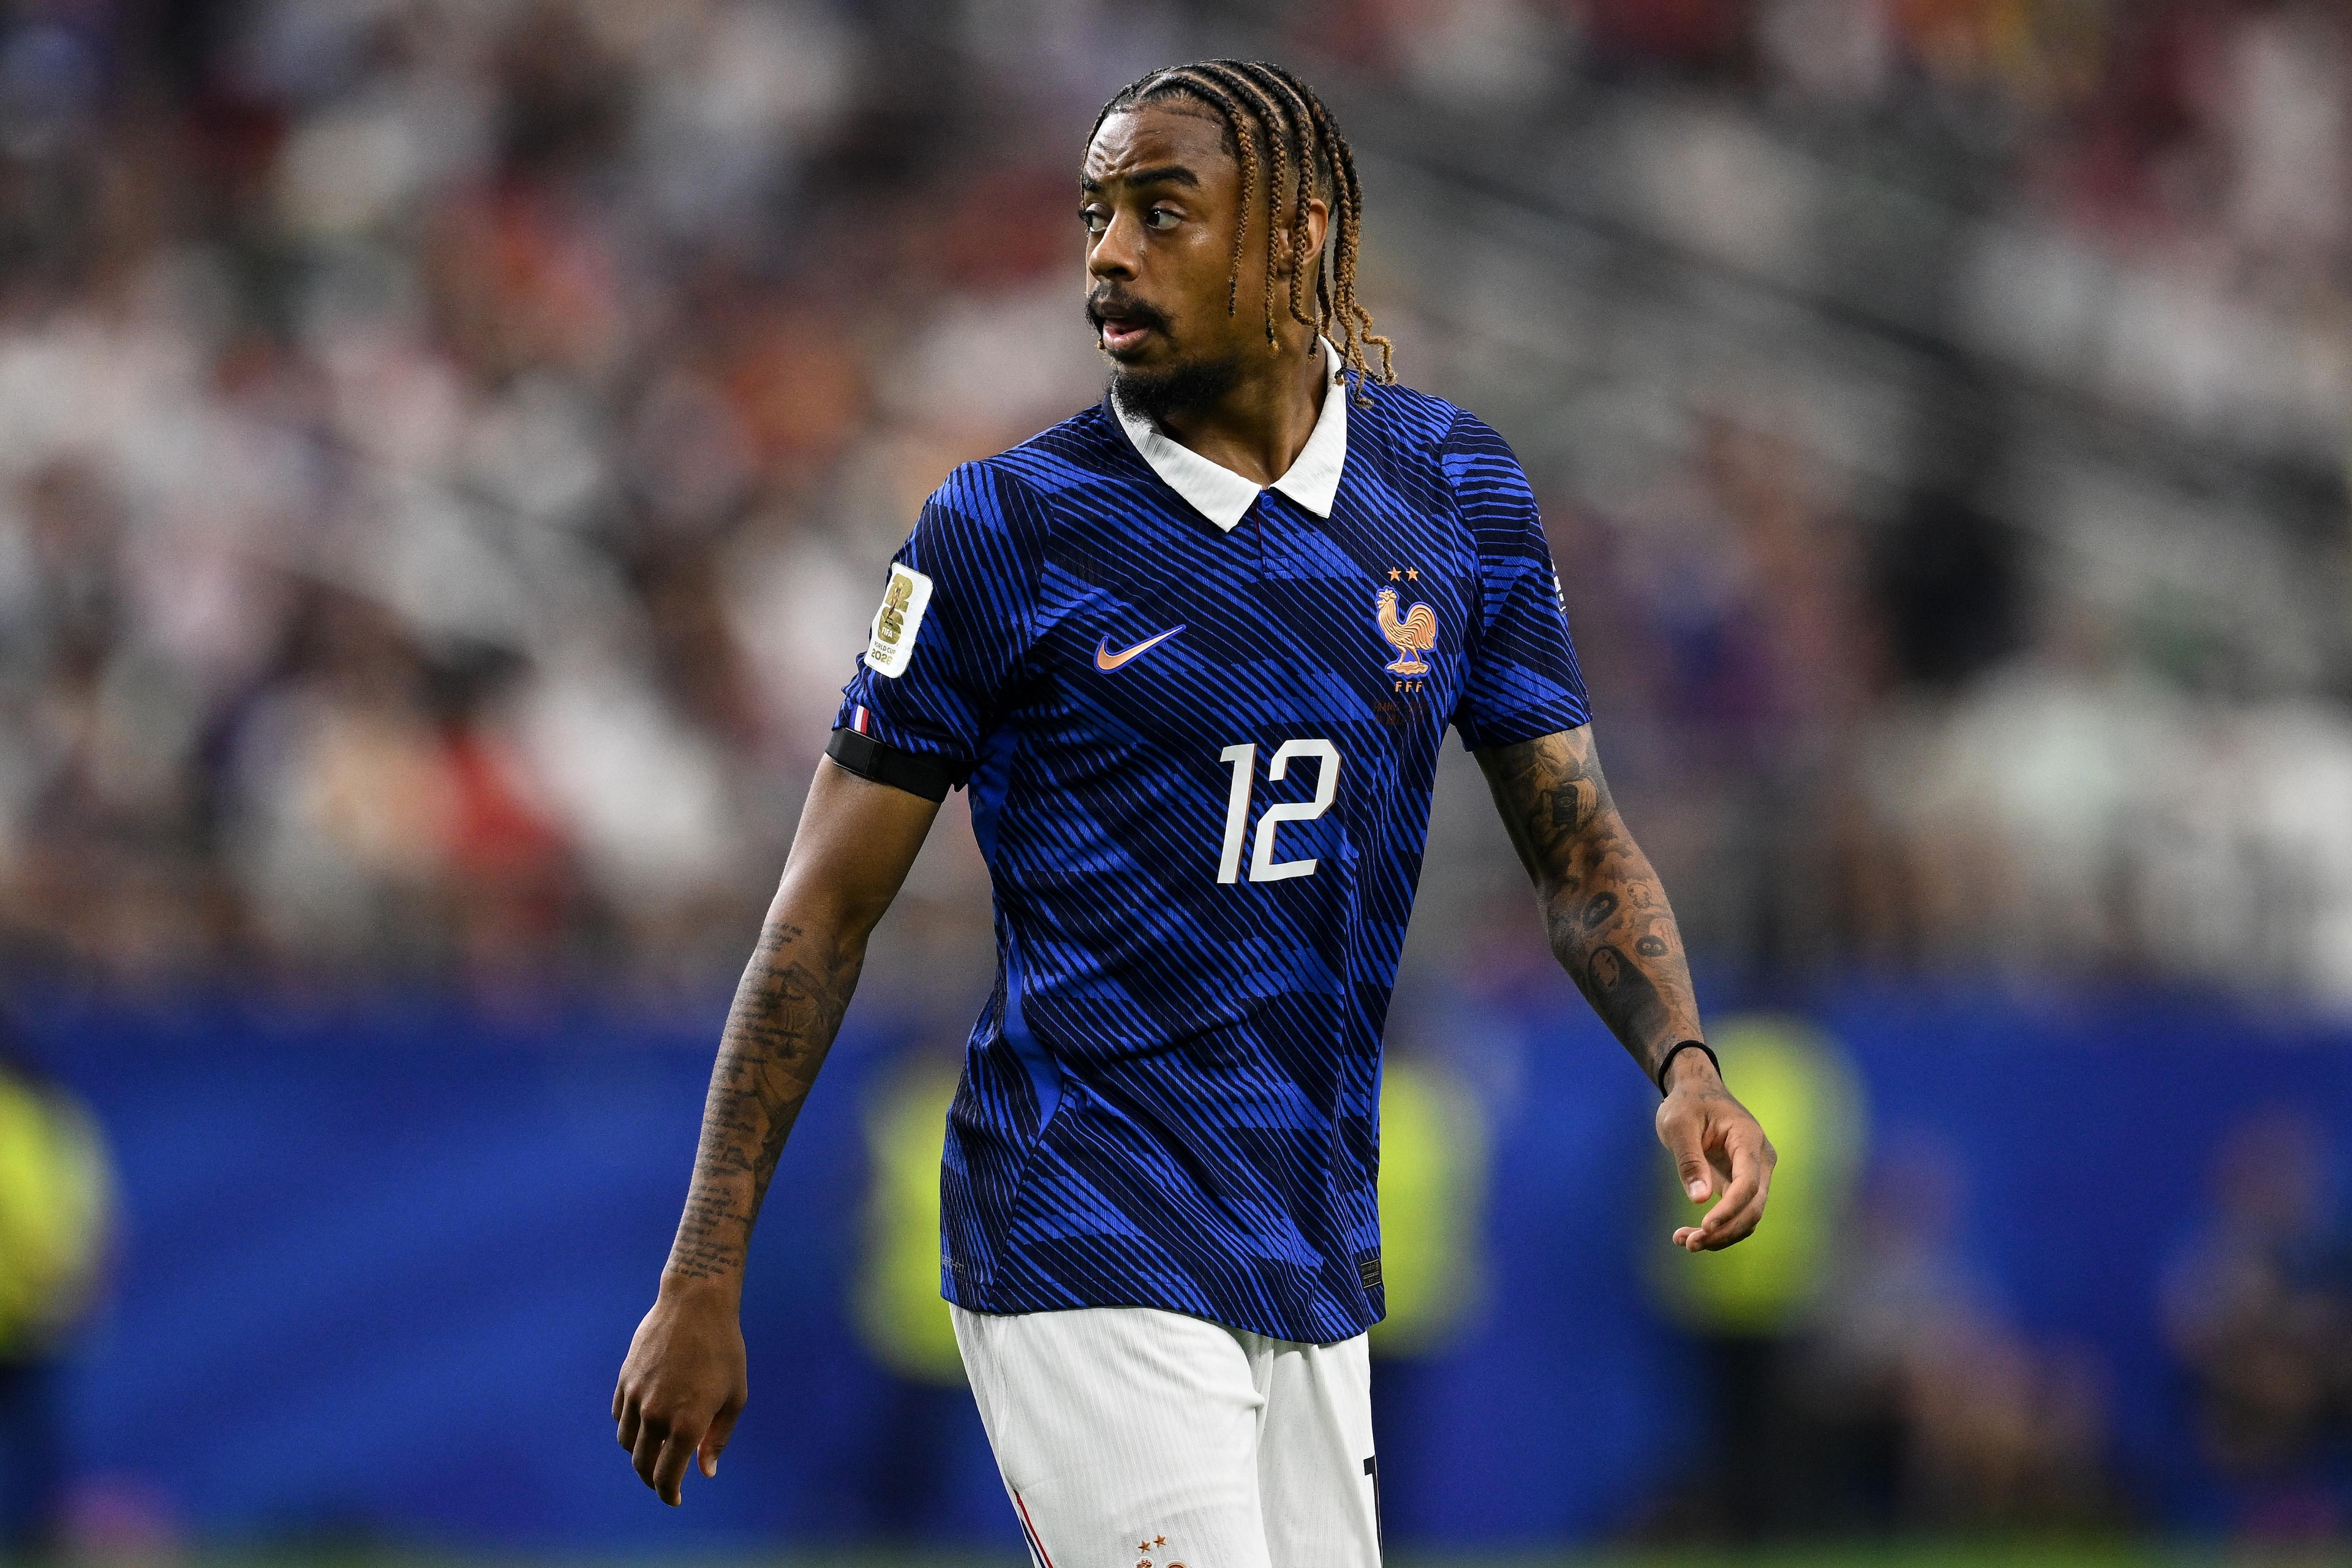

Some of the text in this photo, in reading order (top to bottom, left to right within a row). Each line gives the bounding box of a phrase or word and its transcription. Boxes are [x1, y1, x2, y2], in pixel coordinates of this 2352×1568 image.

[881, 627, 892, 638] FIFA
[871, 649, 892, 665] 2026
[1395, 681, 1423, 692] FFF
[1216, 739, 1342, 884] 12
